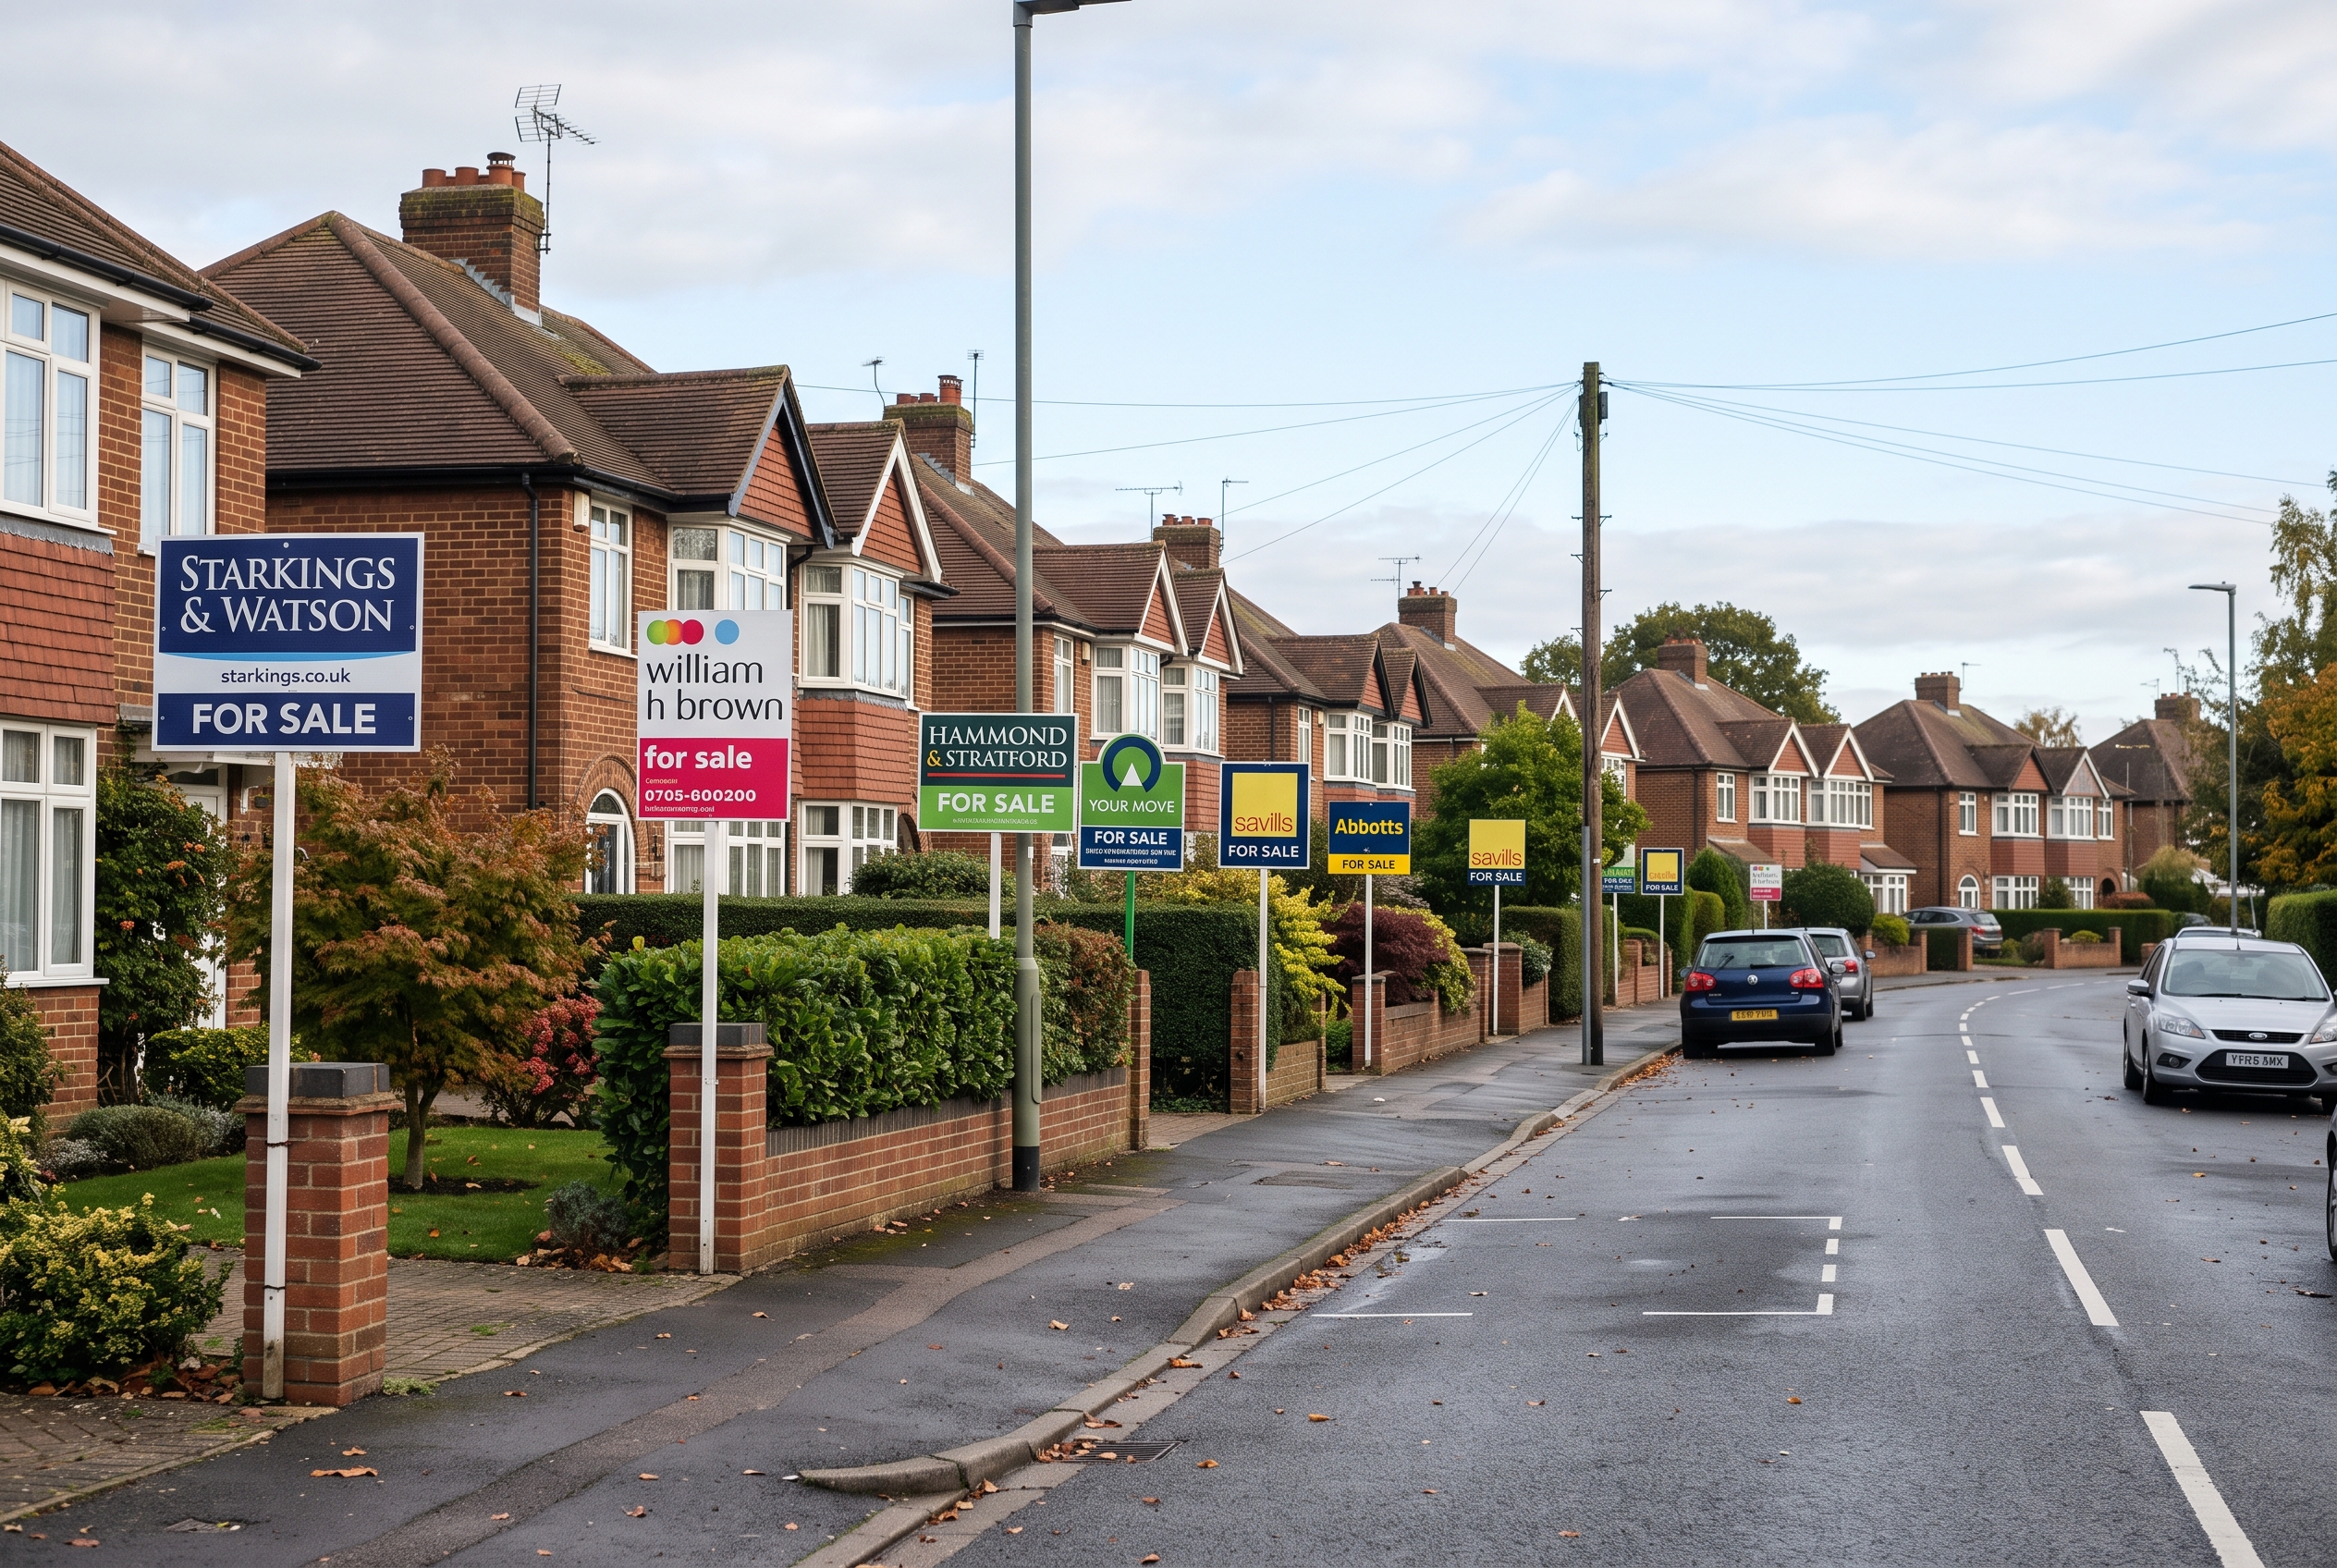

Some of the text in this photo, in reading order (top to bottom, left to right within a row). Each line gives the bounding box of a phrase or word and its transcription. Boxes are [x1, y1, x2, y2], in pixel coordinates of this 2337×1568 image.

[180, 555, 396, 592] STARKINGS
[180, 596, 395, 633] & WATSON
[221, 668, 351, 686] starkings.co.uk
[646, 653, 763, 684] william
[647, 688, 783, 720] h brown
[192, 702, 376, 734] FOR SALE
[928, 726, 1068, 746] HAMMOND
[644, 744, 752, 769] for sale
[926, 750, 1068, 767] & STRATFORD
[644, 789, 756, 802] 0705-600200
[937, 792, 1055, 814] FOR SALE
[1089, 799, 1175, 813] YOUR MOVE
[1234, 812, 1293, 832] savills
[1334, 818, 1404, 835] Abbotts
[1095, 830, 1168, 845] FOR SALE
[1228, 845, 1300, 858] FOR SALE
[1471, 849, 1523, 866] savills
[1342, 859, 1396, 869] FOR SALE
[1470, 872, 1523, 881] FOR SALE
